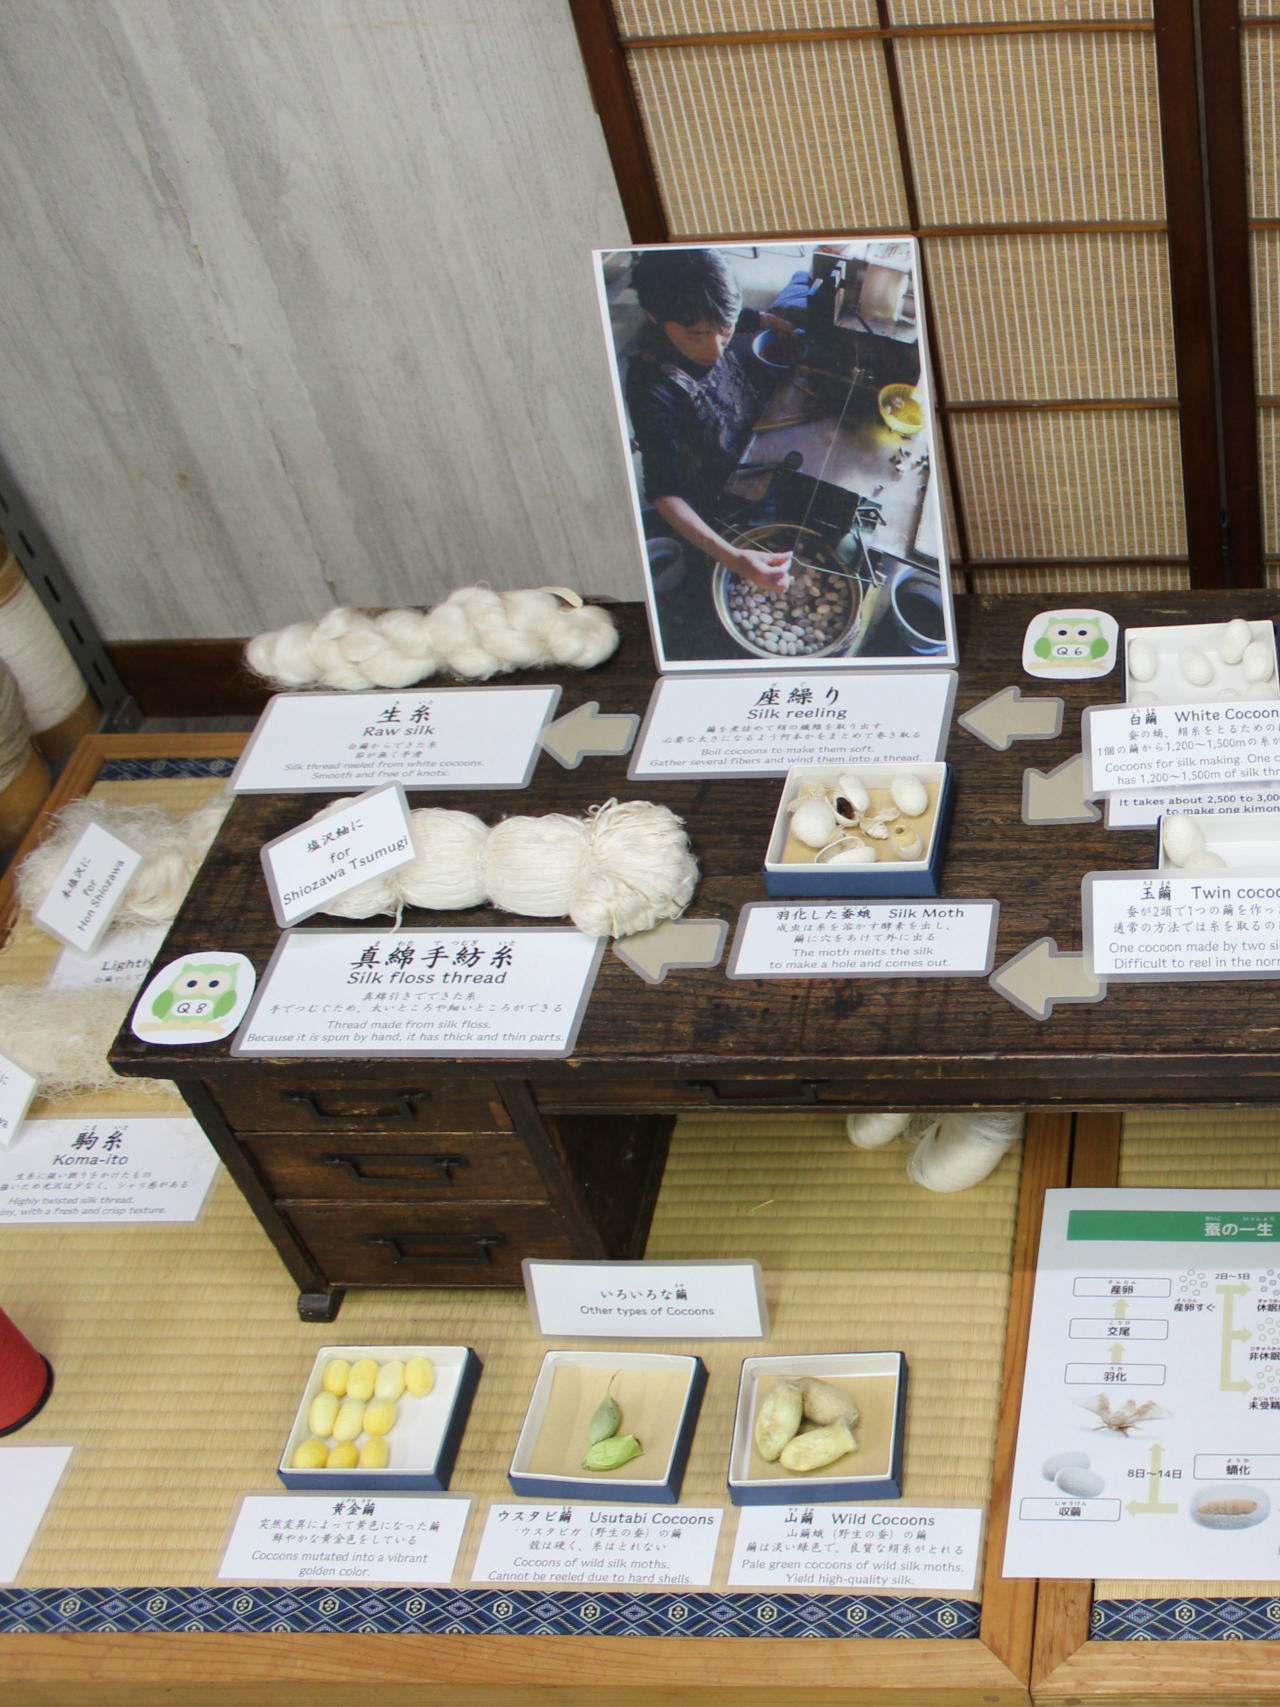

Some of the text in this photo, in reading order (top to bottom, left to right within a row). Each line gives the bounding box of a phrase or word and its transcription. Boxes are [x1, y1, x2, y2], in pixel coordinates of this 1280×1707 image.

[754, 686, 839, 706] 座繰り
[376, 705, 430, 724] 生糸
[747, 707, 847, 720] Silk reeling
[1129, 712, 1158, 726] 白繭
[1174, 710, 1220, 723] White
[362, 725, 435, 737] Raw silk
[701, 748, 722, 756] Boil
[849, 745, 875, 753] soft.
[1133, 798, 1165, 806] takes
[1168, 796, 1203, 805] about
[1207, 795, 1236, 804] 2,500
[1239, 795, 1253, 803] to
[329, 847, 351, 864] for
[283, 835, 409, 906] Shiozawa Tsumugi
[82, 879, 98, 897] for
[1140, 887, 1172, 901] 玉繭
[1191, 886, 1231, 899] Twin
[77, 859, 125, 932] Hon Shiozawa
[888, 908, 917, 919] Silk
[922, 908, 964, 918] Moth
[792, 947, 934, 957] The moth melts the silk
[1109, 942, 1134, 953] One
[1138, 944, 1182, 953] cocoon
[1186, 941, 1219, 952] made
[1223, 941, 1238, 953] by
[1241, 941, 1266, 951] two
[349, 946, 514, 970] 真綿手紡糸
[101, 958, 153, 972] Lightly
[346, 971, 507, 984] Silk floss thread
[327, 1020, 491, 1029] Thread made from silk floss.
[71, 1130, 124, 1151] 駒糸
[52, 1154, 129, 1166] Koma-ito
[1204, 1222, 1274, 1237] 蚕の一生
[600, 1288, 688, 1301] いろいろな繭
[1110, 1284, 1134, 1295] 産卵
[580, 1305, 715, 1317] Other types of Cocoons
[1173, 1302, 1216, 1313] 産卵すぐ
[1106, 1326, 1131, 1337] 交尾
[1103, 1371, 1127, 1382] 羽化
[1225, 1464, 1251, 1476] 蛹化
[331, 1503, 376, 1517] 黄金繭
[498, 1510, 714, 1525] ウスタビ繭 Usutabi Cocoons
[784, 1510, 935, 1526] 山繭 Wild Cocoons
[251, 1550, 429, 1563] Cocoons mutated into a vibrant
[786, 1573, 914, 1586] Yield high-quality silk.
